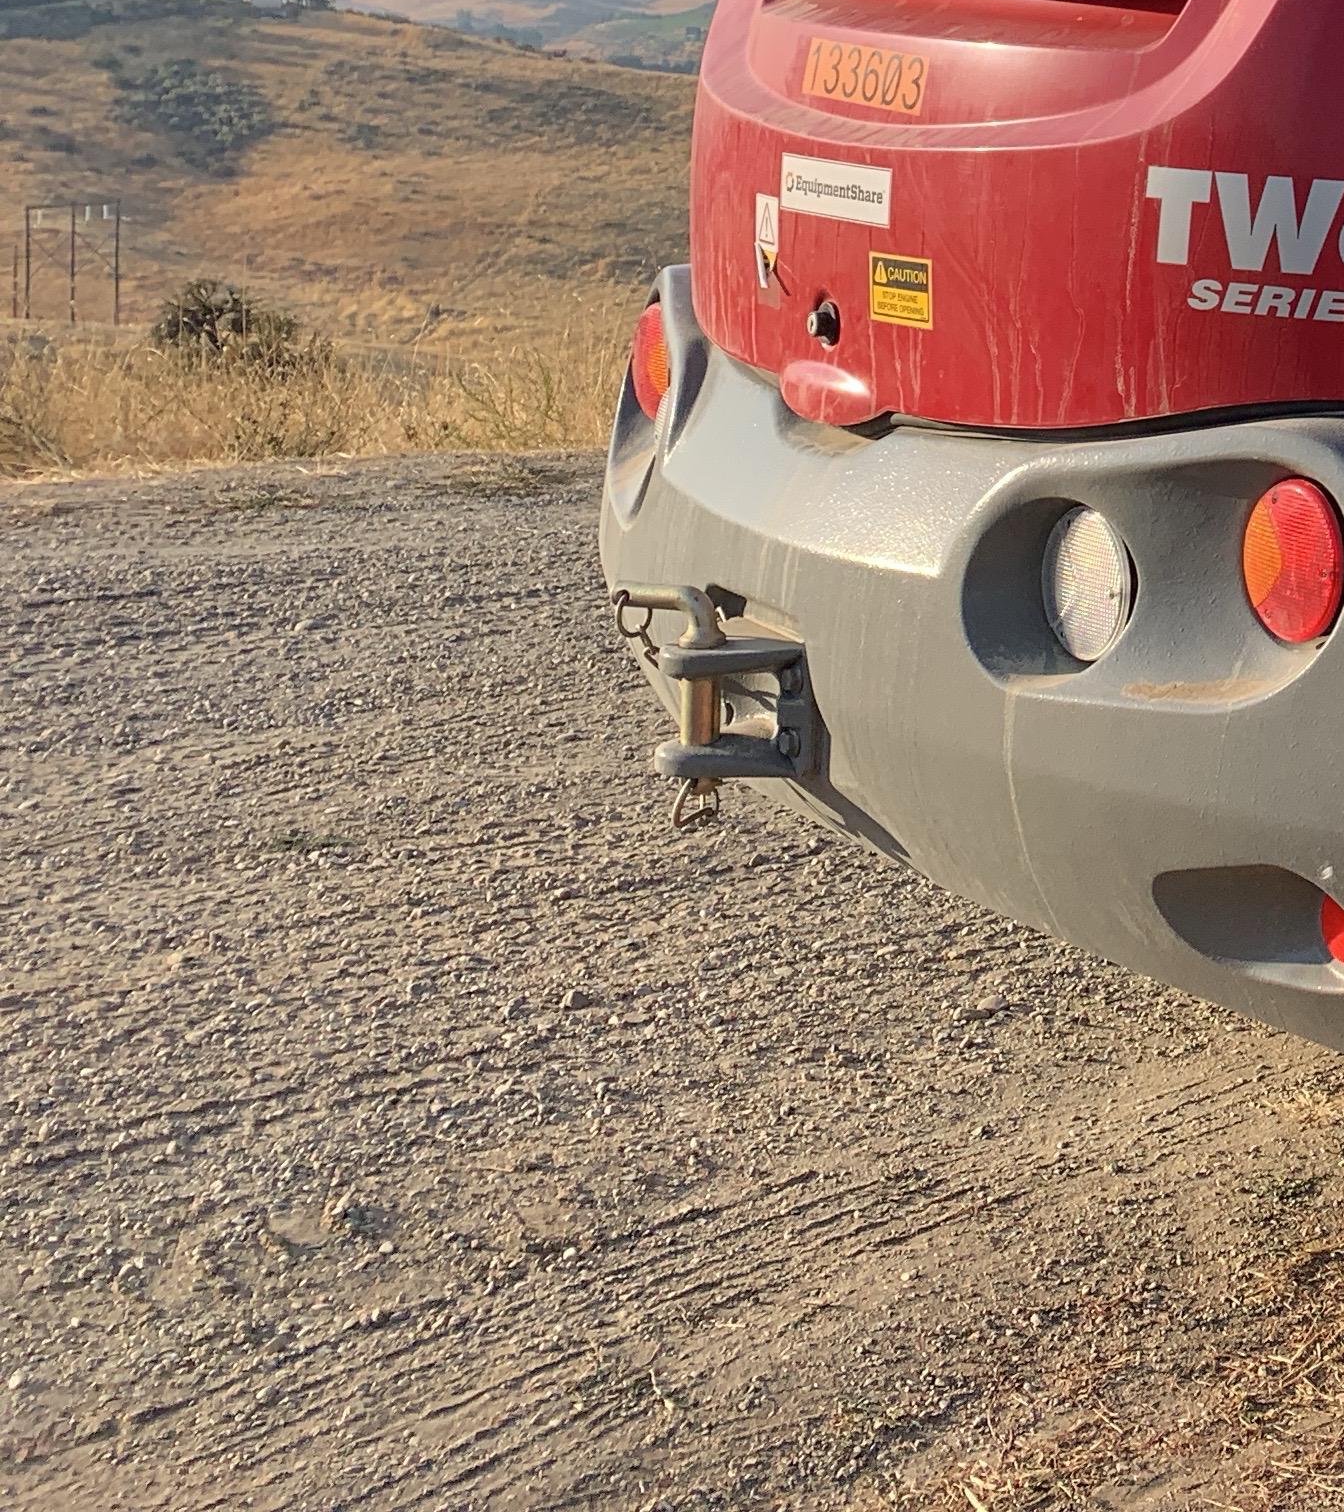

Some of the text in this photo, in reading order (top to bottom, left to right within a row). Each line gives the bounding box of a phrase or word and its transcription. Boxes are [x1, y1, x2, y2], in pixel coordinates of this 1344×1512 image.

[811, 42, 924, 110] 133603
[795, 175, 883, 204] EquipmentShare
[887, 267, 927, 285] CAUTION
[882, 291, 918, 304] STOP ENGINE
[877, 302, 924, 316] BEFORE OPENING
